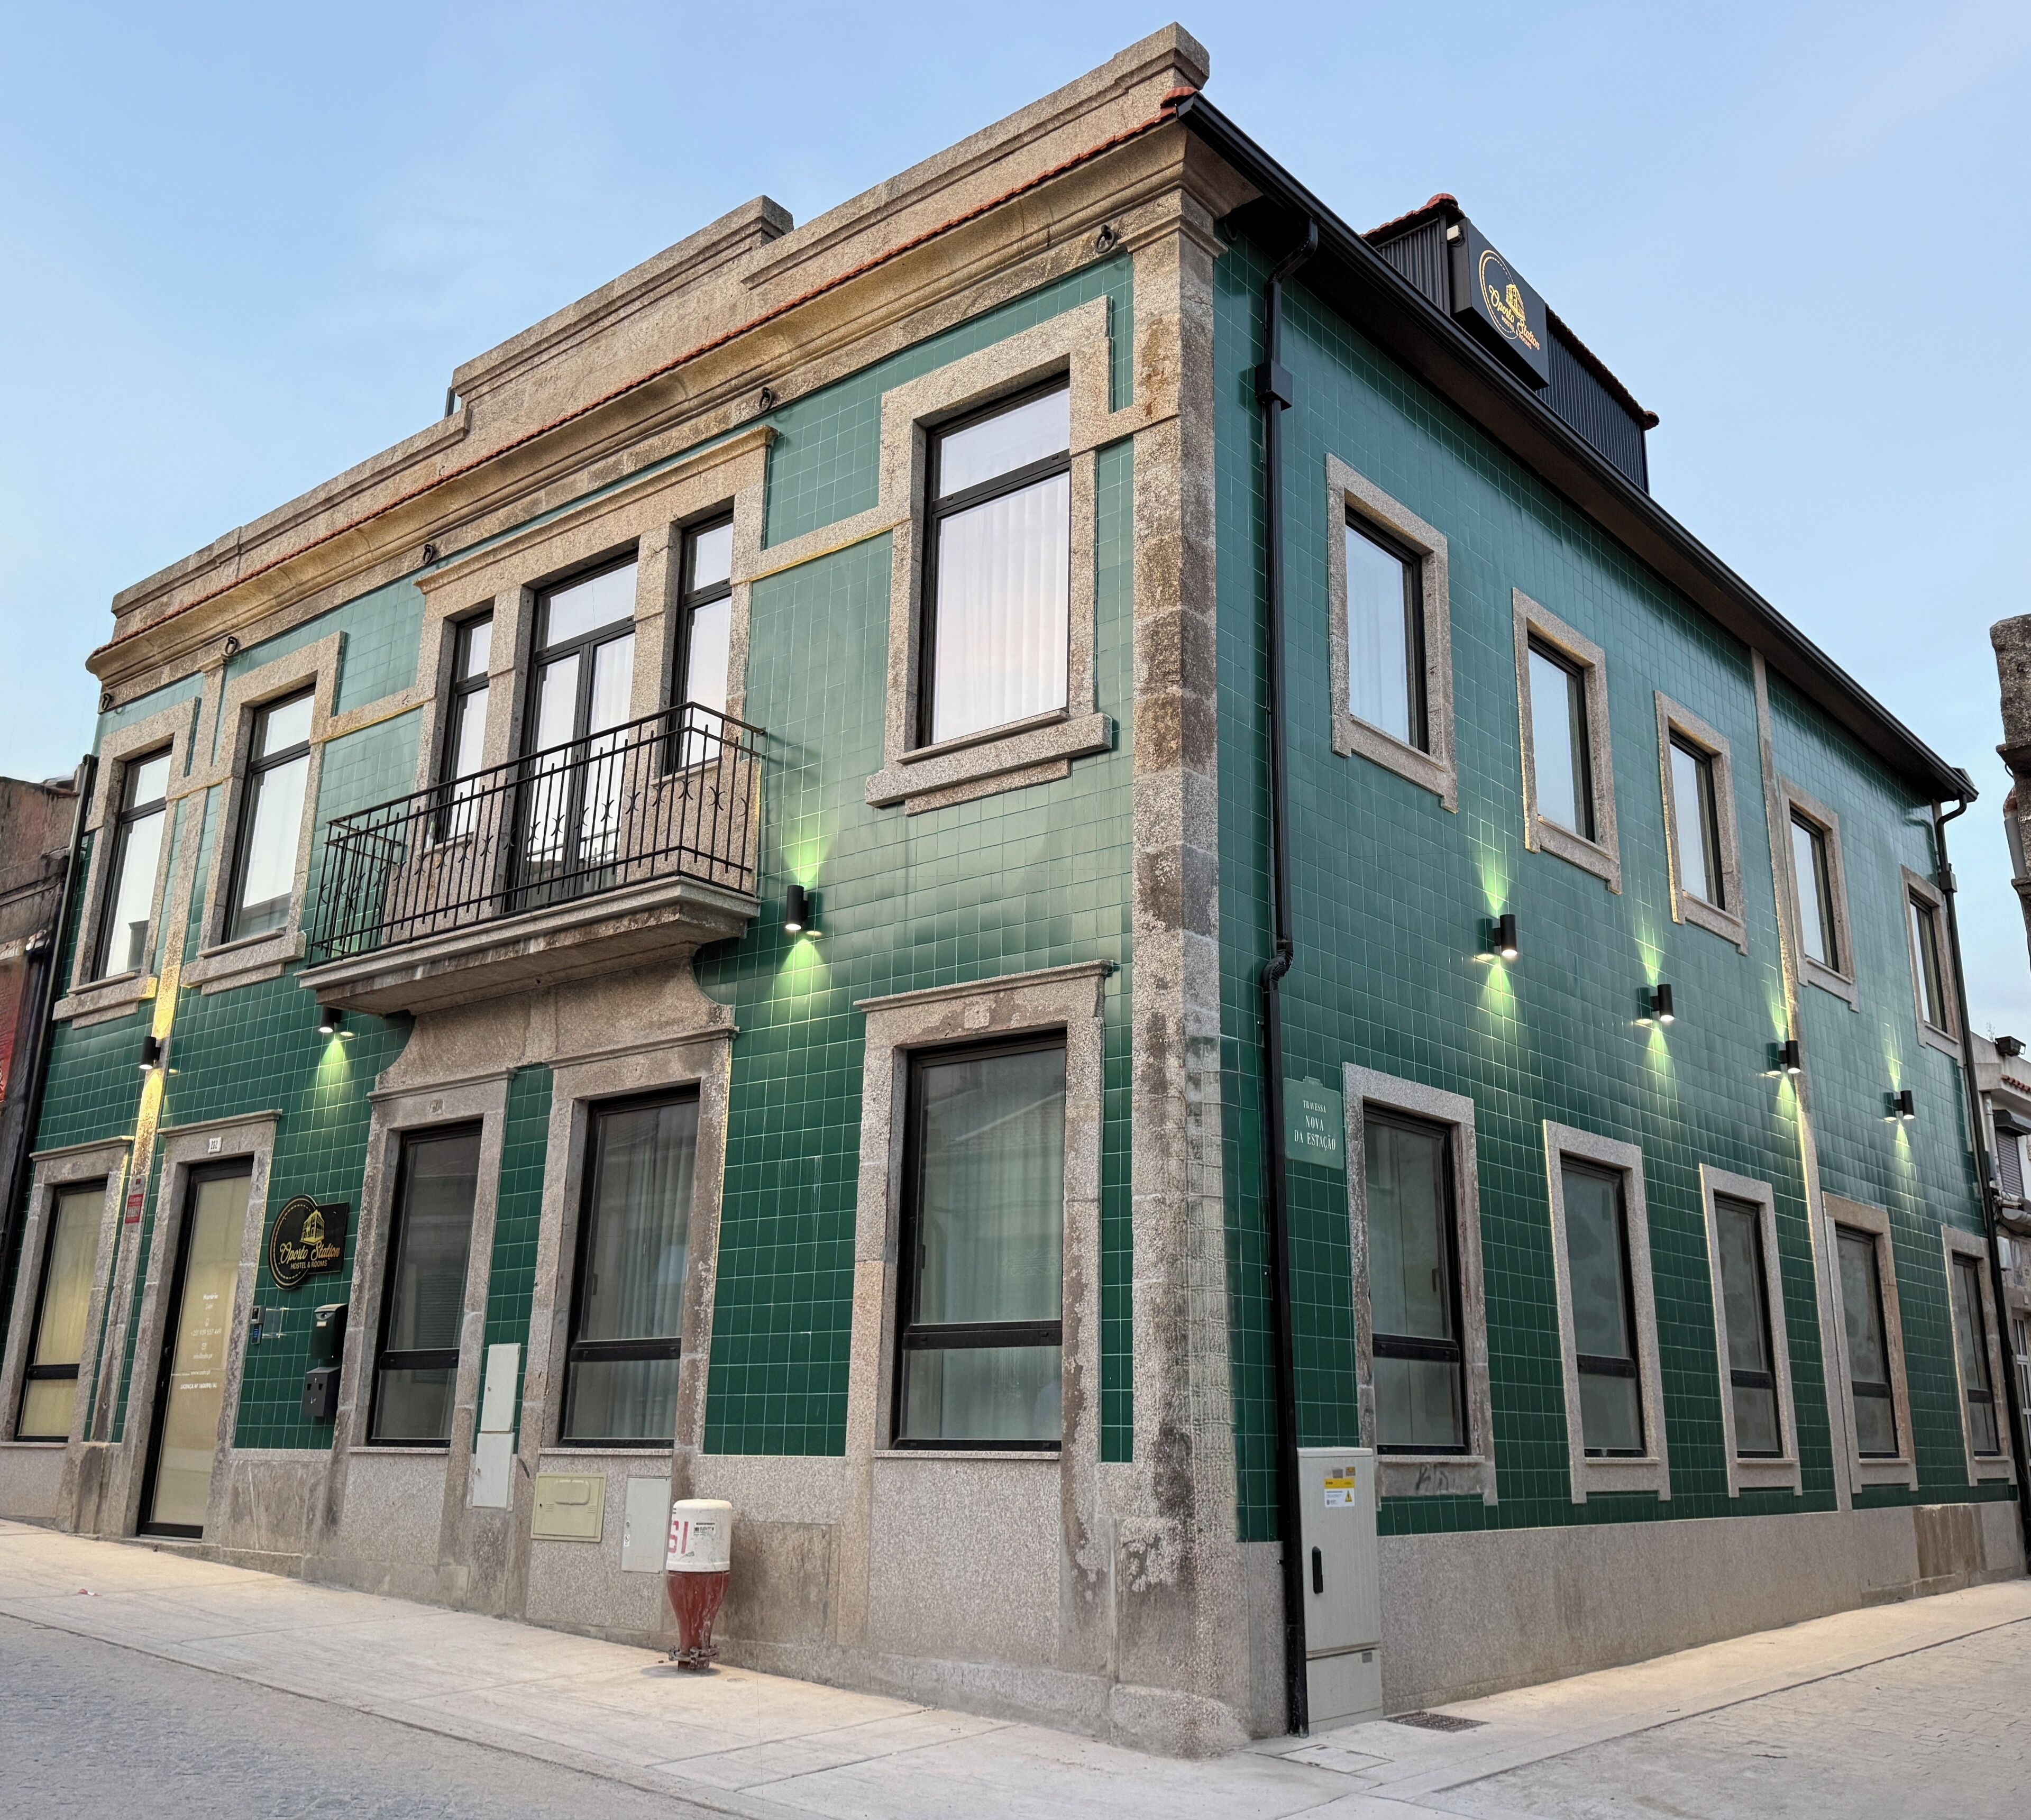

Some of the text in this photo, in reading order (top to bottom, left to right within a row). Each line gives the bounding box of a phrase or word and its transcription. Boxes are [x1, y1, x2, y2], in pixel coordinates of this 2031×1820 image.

[1489, 285, 1540, 350] Oporto Station
[1501, 314, 1516, 334] HOSTEL
[1303, 1100, 1326, 1113] TRAVESSA
[1305, 1115, 1324, 1131] NOVA
[1294, 1129, 1336, 1151] DA ESTAÇÃO
[279, 1241, 341, 1265] Oporto Station
[290, 1261, 307, 1270] HOSTEL
[311, 1259, 327, 1268] ROOMS
